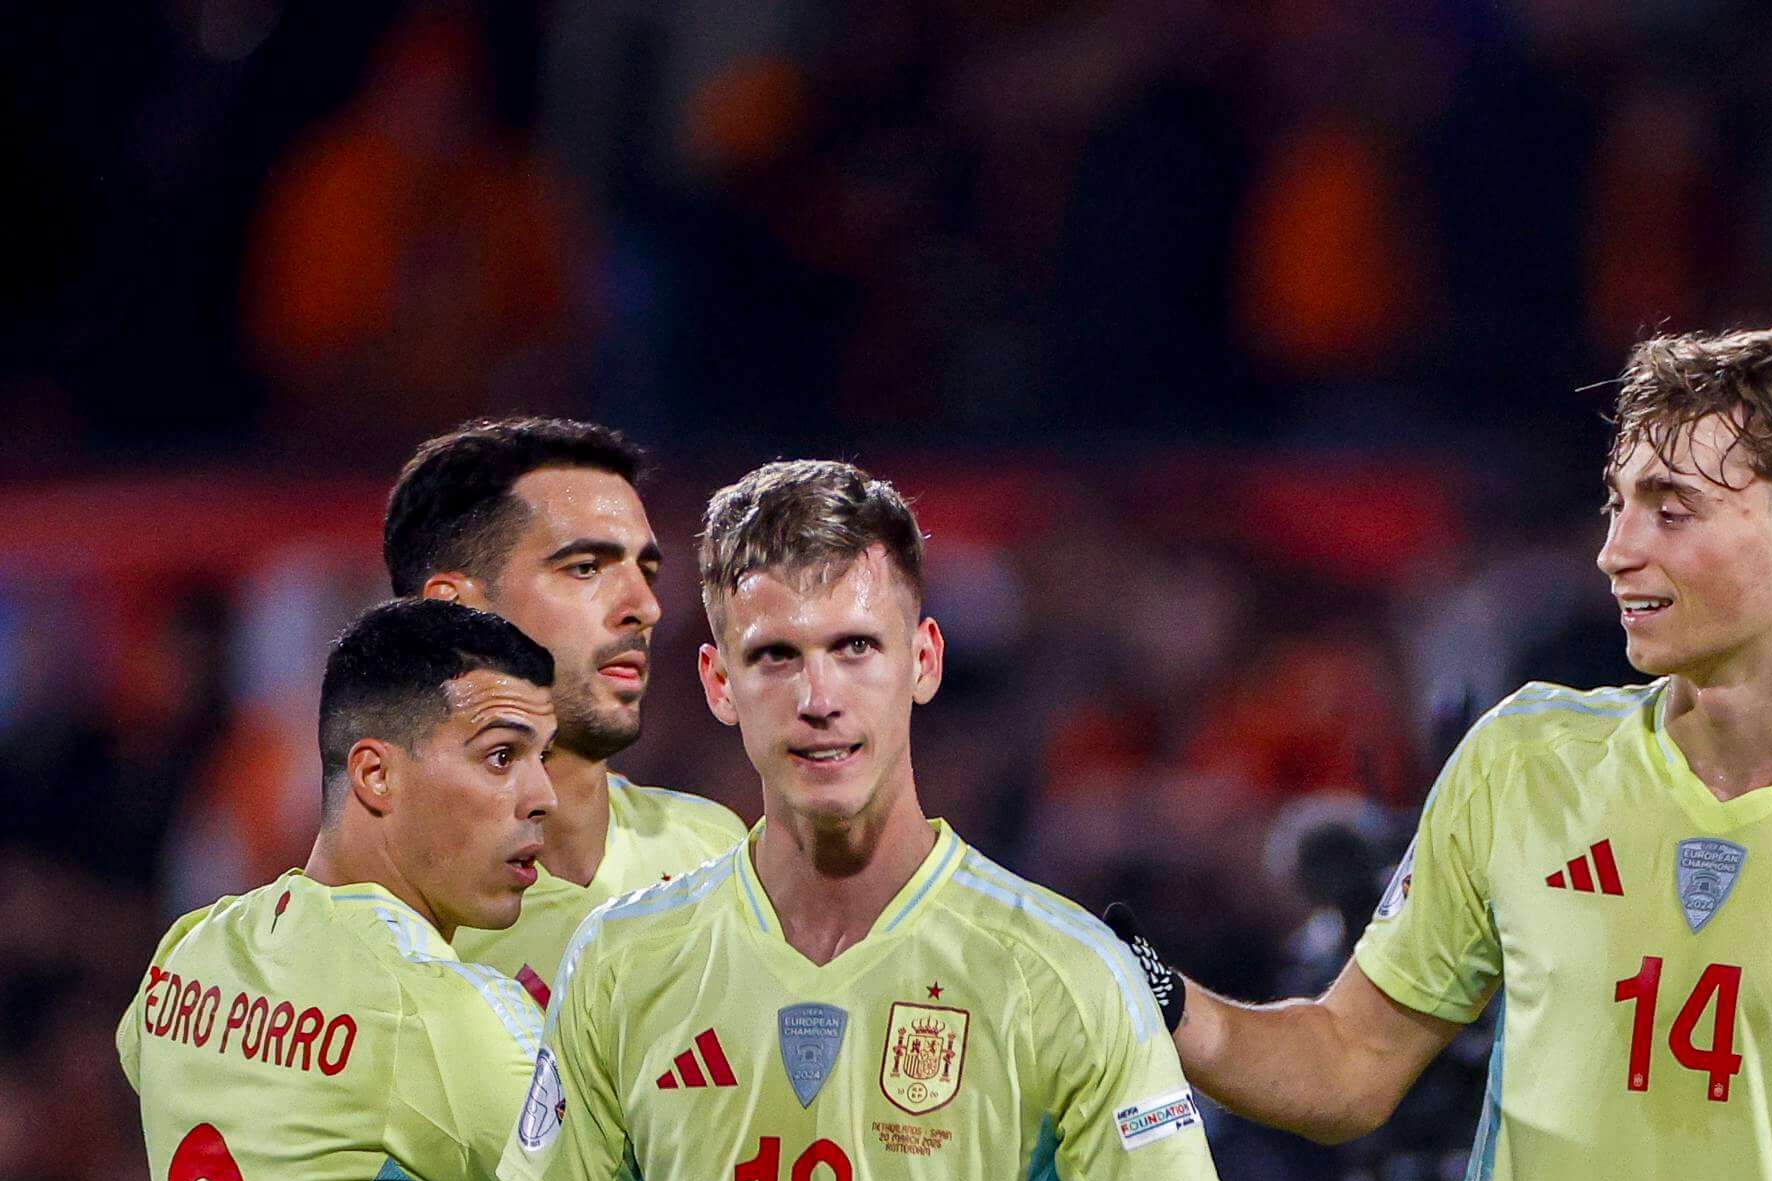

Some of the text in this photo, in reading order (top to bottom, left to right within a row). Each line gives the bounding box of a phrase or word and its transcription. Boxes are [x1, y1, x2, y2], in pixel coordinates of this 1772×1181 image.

[1684, 848, 1738, 864] EUROPEAN
[219, 991, 358, 1076] PORRO
[784, 1016, 840, 1028] EUROPEAN
[784, 1027, 838, 1037] CHAMPIONS
[1615, 956, 1742, 1102] 14
[1120, 1103, 1191, 1136] FOUNDATION
